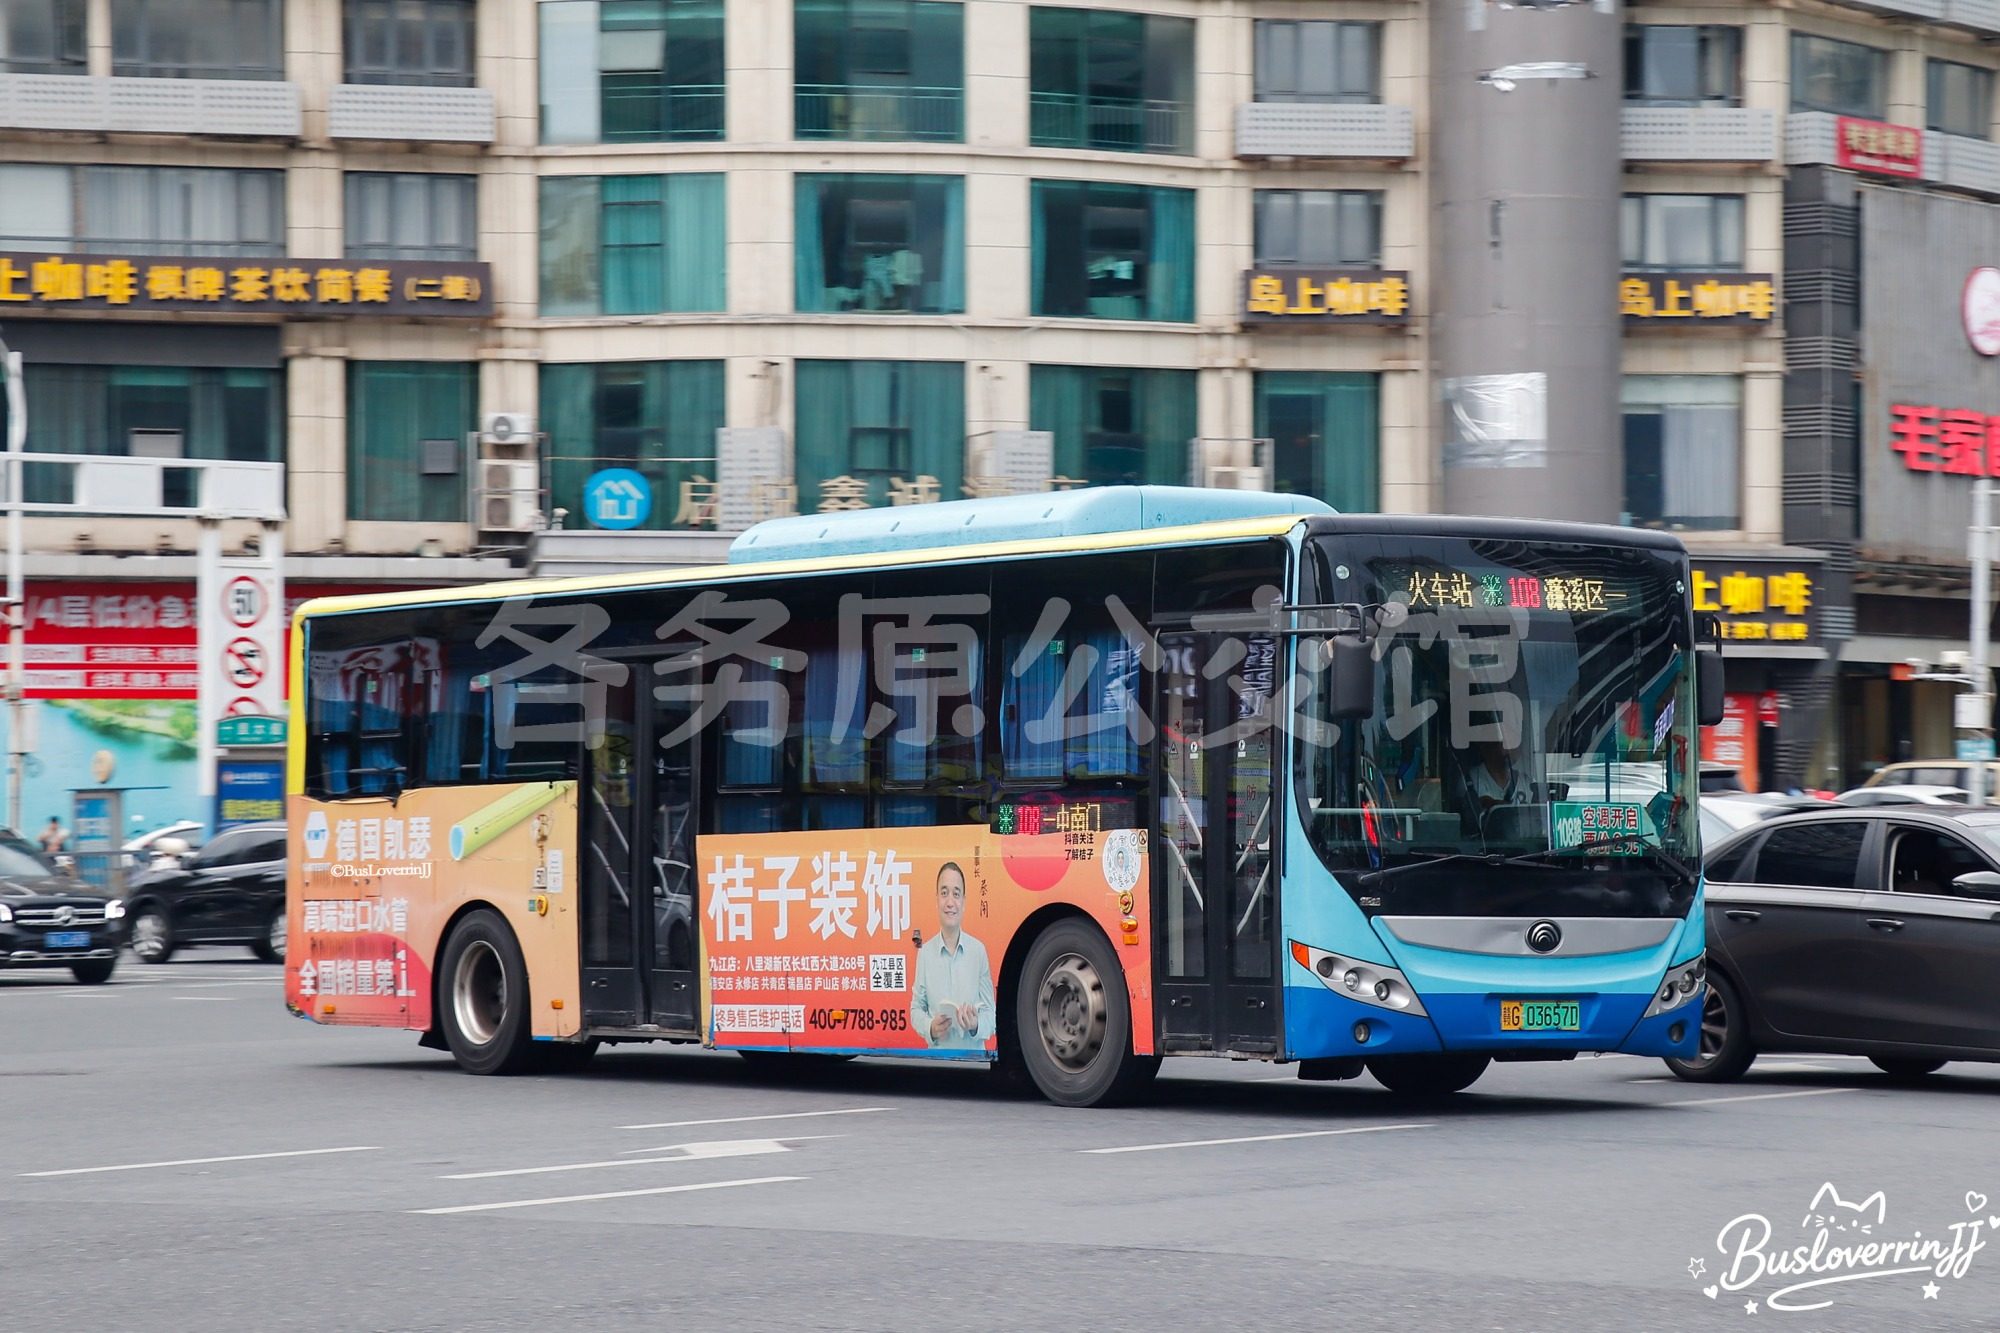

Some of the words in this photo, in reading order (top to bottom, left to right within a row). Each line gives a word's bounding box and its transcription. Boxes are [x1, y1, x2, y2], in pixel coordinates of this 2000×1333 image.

[1408, 571, 1474, 608] 火车站
[1508, 577, 1542, 609] 108
[1017, 805, 1040, 835] 108
[1582, 806, 1639, 829] 空调开启
[335, 816, 432, 861] 德国凯瑟
[1064, 832, 1095, 846] 抖音关注
[1176, 786, 1190, 881] 注意开门
[1064, 848, 1095, 861] 了解桔子
[706, 848, 913, 942] 桔子装饰
[303, 897, 409, 933] 高端进口水管
[871, 956, 905, 971] 九江县区
[709, 976, 734, 991] 德安店
[735, 976, 760, 991] 永修店
[761, 976, 787, 991] 共青店
[787, 976, 812, 991] 瑞昌店
[814, 976, 840, 991] 庐山店
[841, 976, 867, 991] 修水店
[871, 971, 905, 989] 全覆盖
[714, 1008, 803, 1029] 终身售后维护电话
[808, 1008, 907, 1031] 400-7788-985
